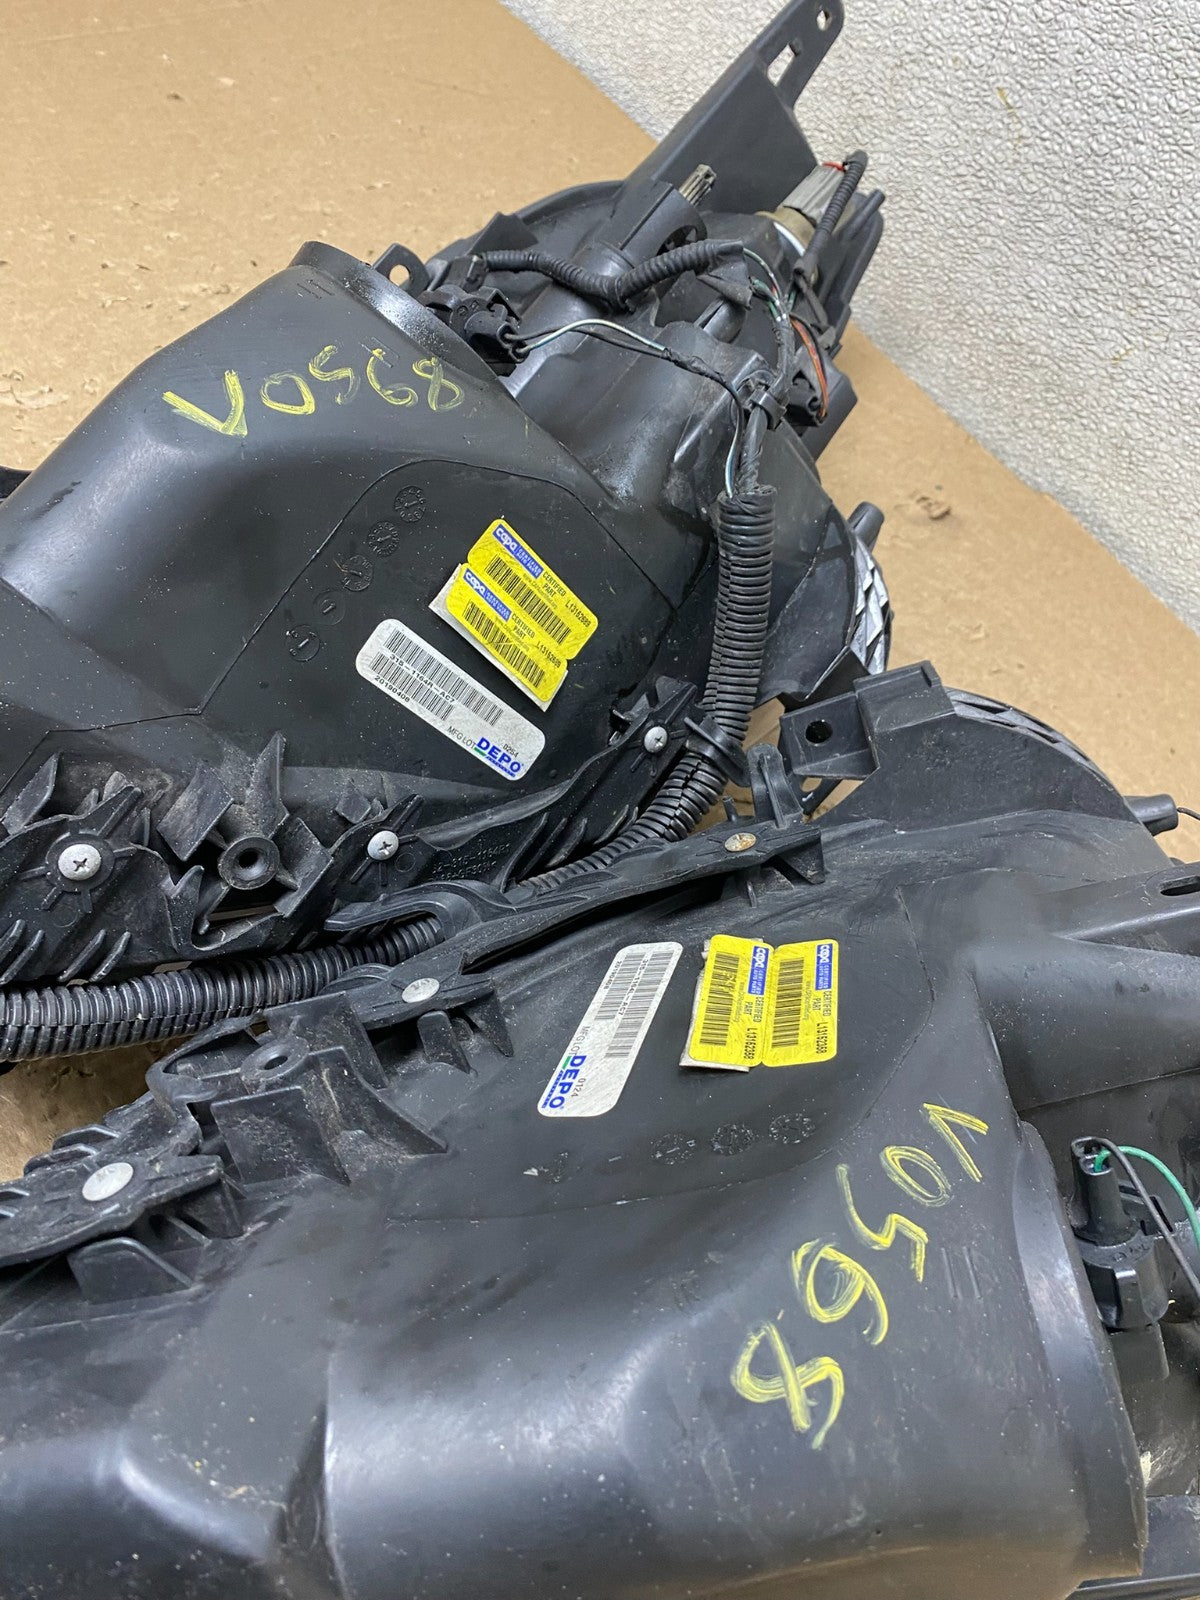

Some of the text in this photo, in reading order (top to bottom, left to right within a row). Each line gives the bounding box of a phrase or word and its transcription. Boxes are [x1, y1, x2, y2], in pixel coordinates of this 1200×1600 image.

[543, 571, 567, 597] CERTIFIED
[543, 583, 557, 597] PART
[511, 613, 536, 638] CERTIFIED
[513, 625, 526, 639] PART
[447, 725, 477, 749] MFG LOT
[477, 737, 521, 773] DEPO
[744, 1001, 753, 1015] PART
[753, 996, 764, 1022] CERTIFIED
[812, 997, 821, 1011] PART
[823, 990, 832, 1017] CERTIFIED
[568, 1026, 591, 1056] MFG LOT
[549, 1055, 587, 1109] DEPO
[571, 1078, 587, 1098] 0124
